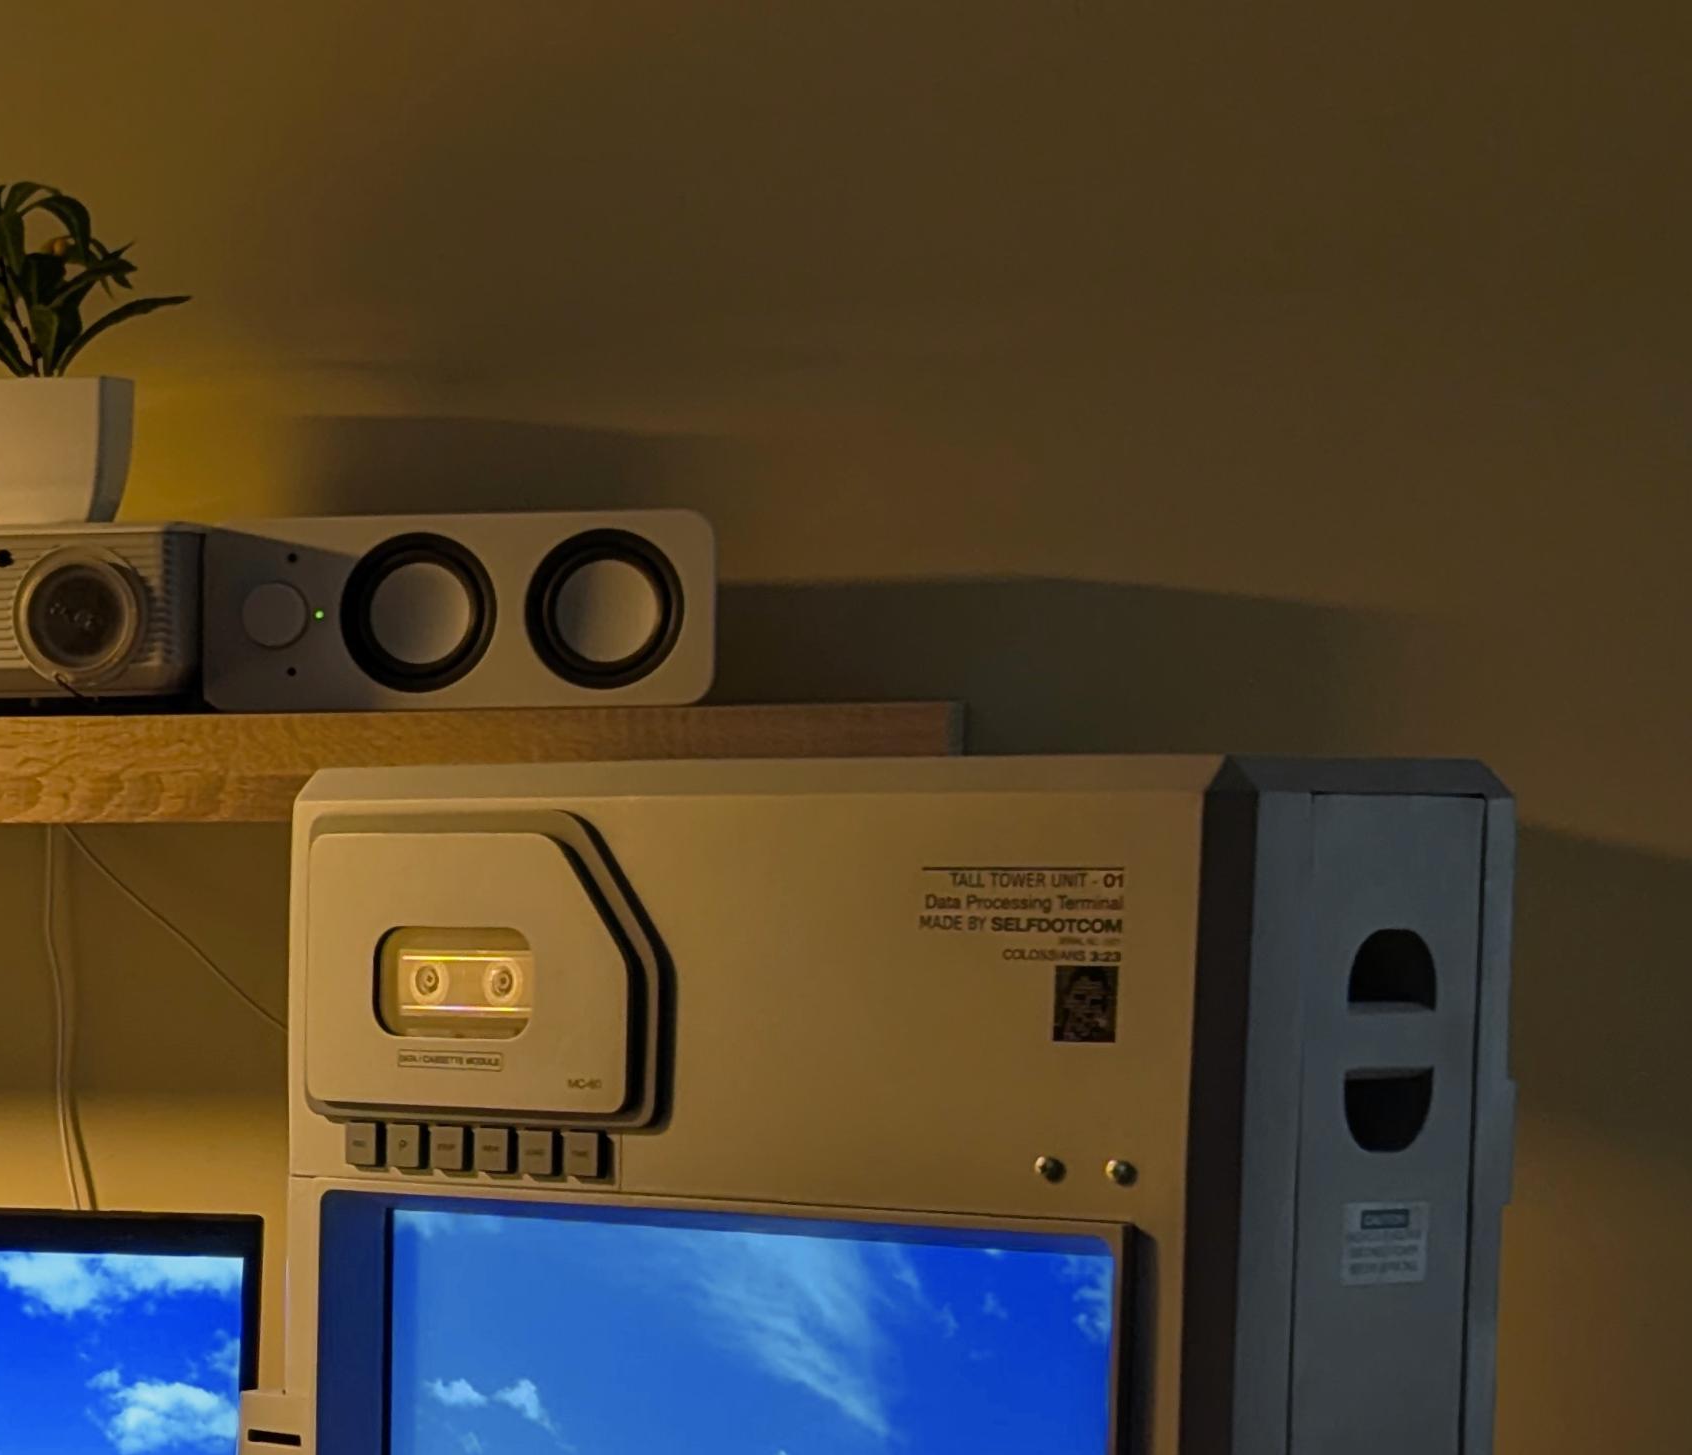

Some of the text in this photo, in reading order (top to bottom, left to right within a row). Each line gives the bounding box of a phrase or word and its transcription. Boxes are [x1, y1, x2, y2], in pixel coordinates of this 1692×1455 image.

[950, 873, 984, 888] TALL
[990, 873, 1045, 888] TOWER
[1051, 873, 1087, 888] UNIT
[1103, 873, 1124, 888] 01
[925, 894, 1124, 913] Data Processing Terminal
[919, 915, 1123, 933] MADE BY SELFDOTCOM
